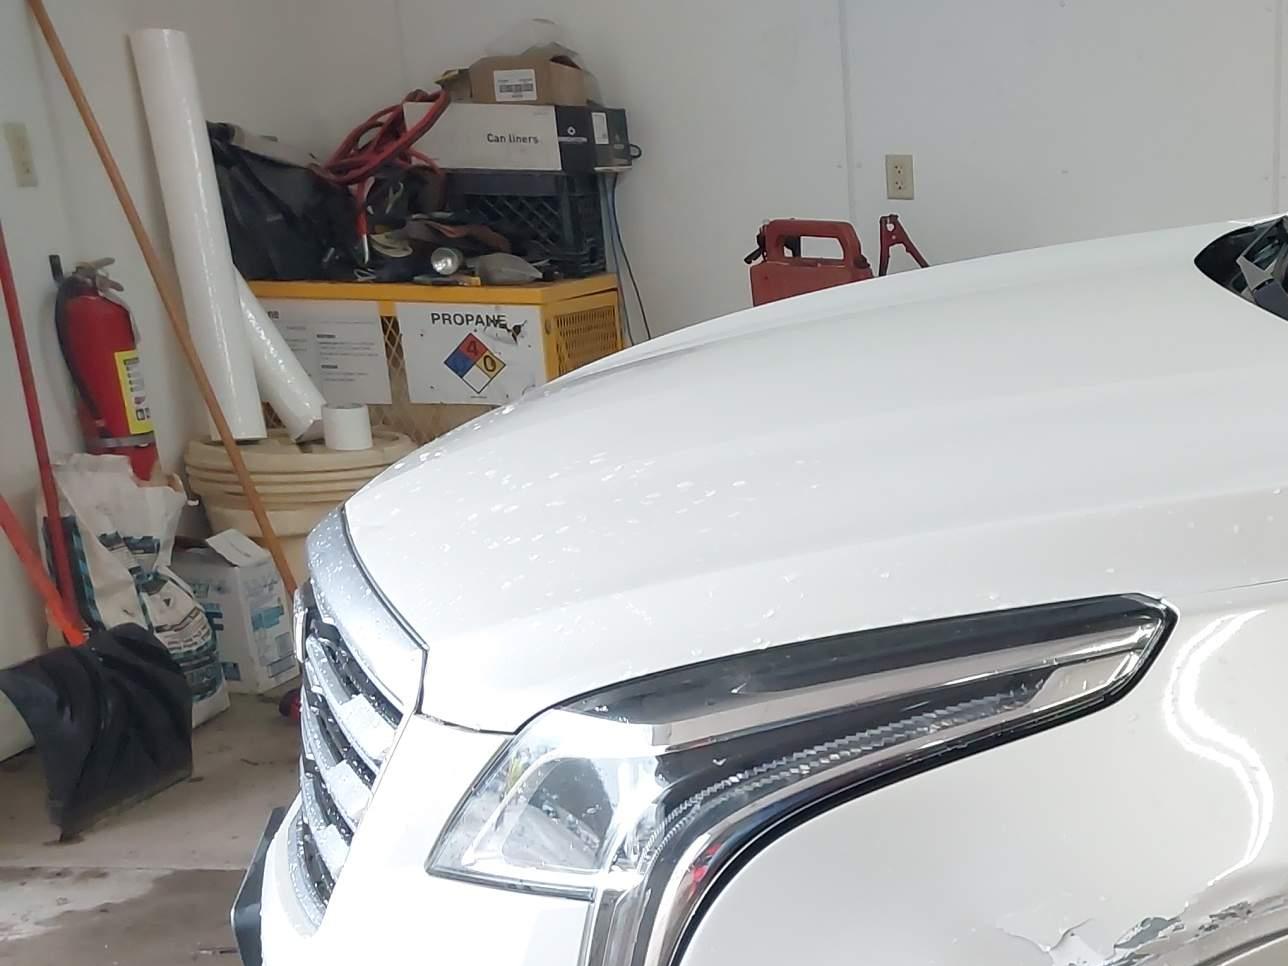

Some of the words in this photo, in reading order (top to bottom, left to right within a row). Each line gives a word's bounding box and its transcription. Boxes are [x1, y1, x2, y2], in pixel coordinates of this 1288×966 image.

[486, 132, 507, 144] Can
[508, 132, 540, 145] liners
[430, 312, 507, 328] PROPANE
[466, 340, 479, 358] 4
[483, 354, 497, 373] 0
